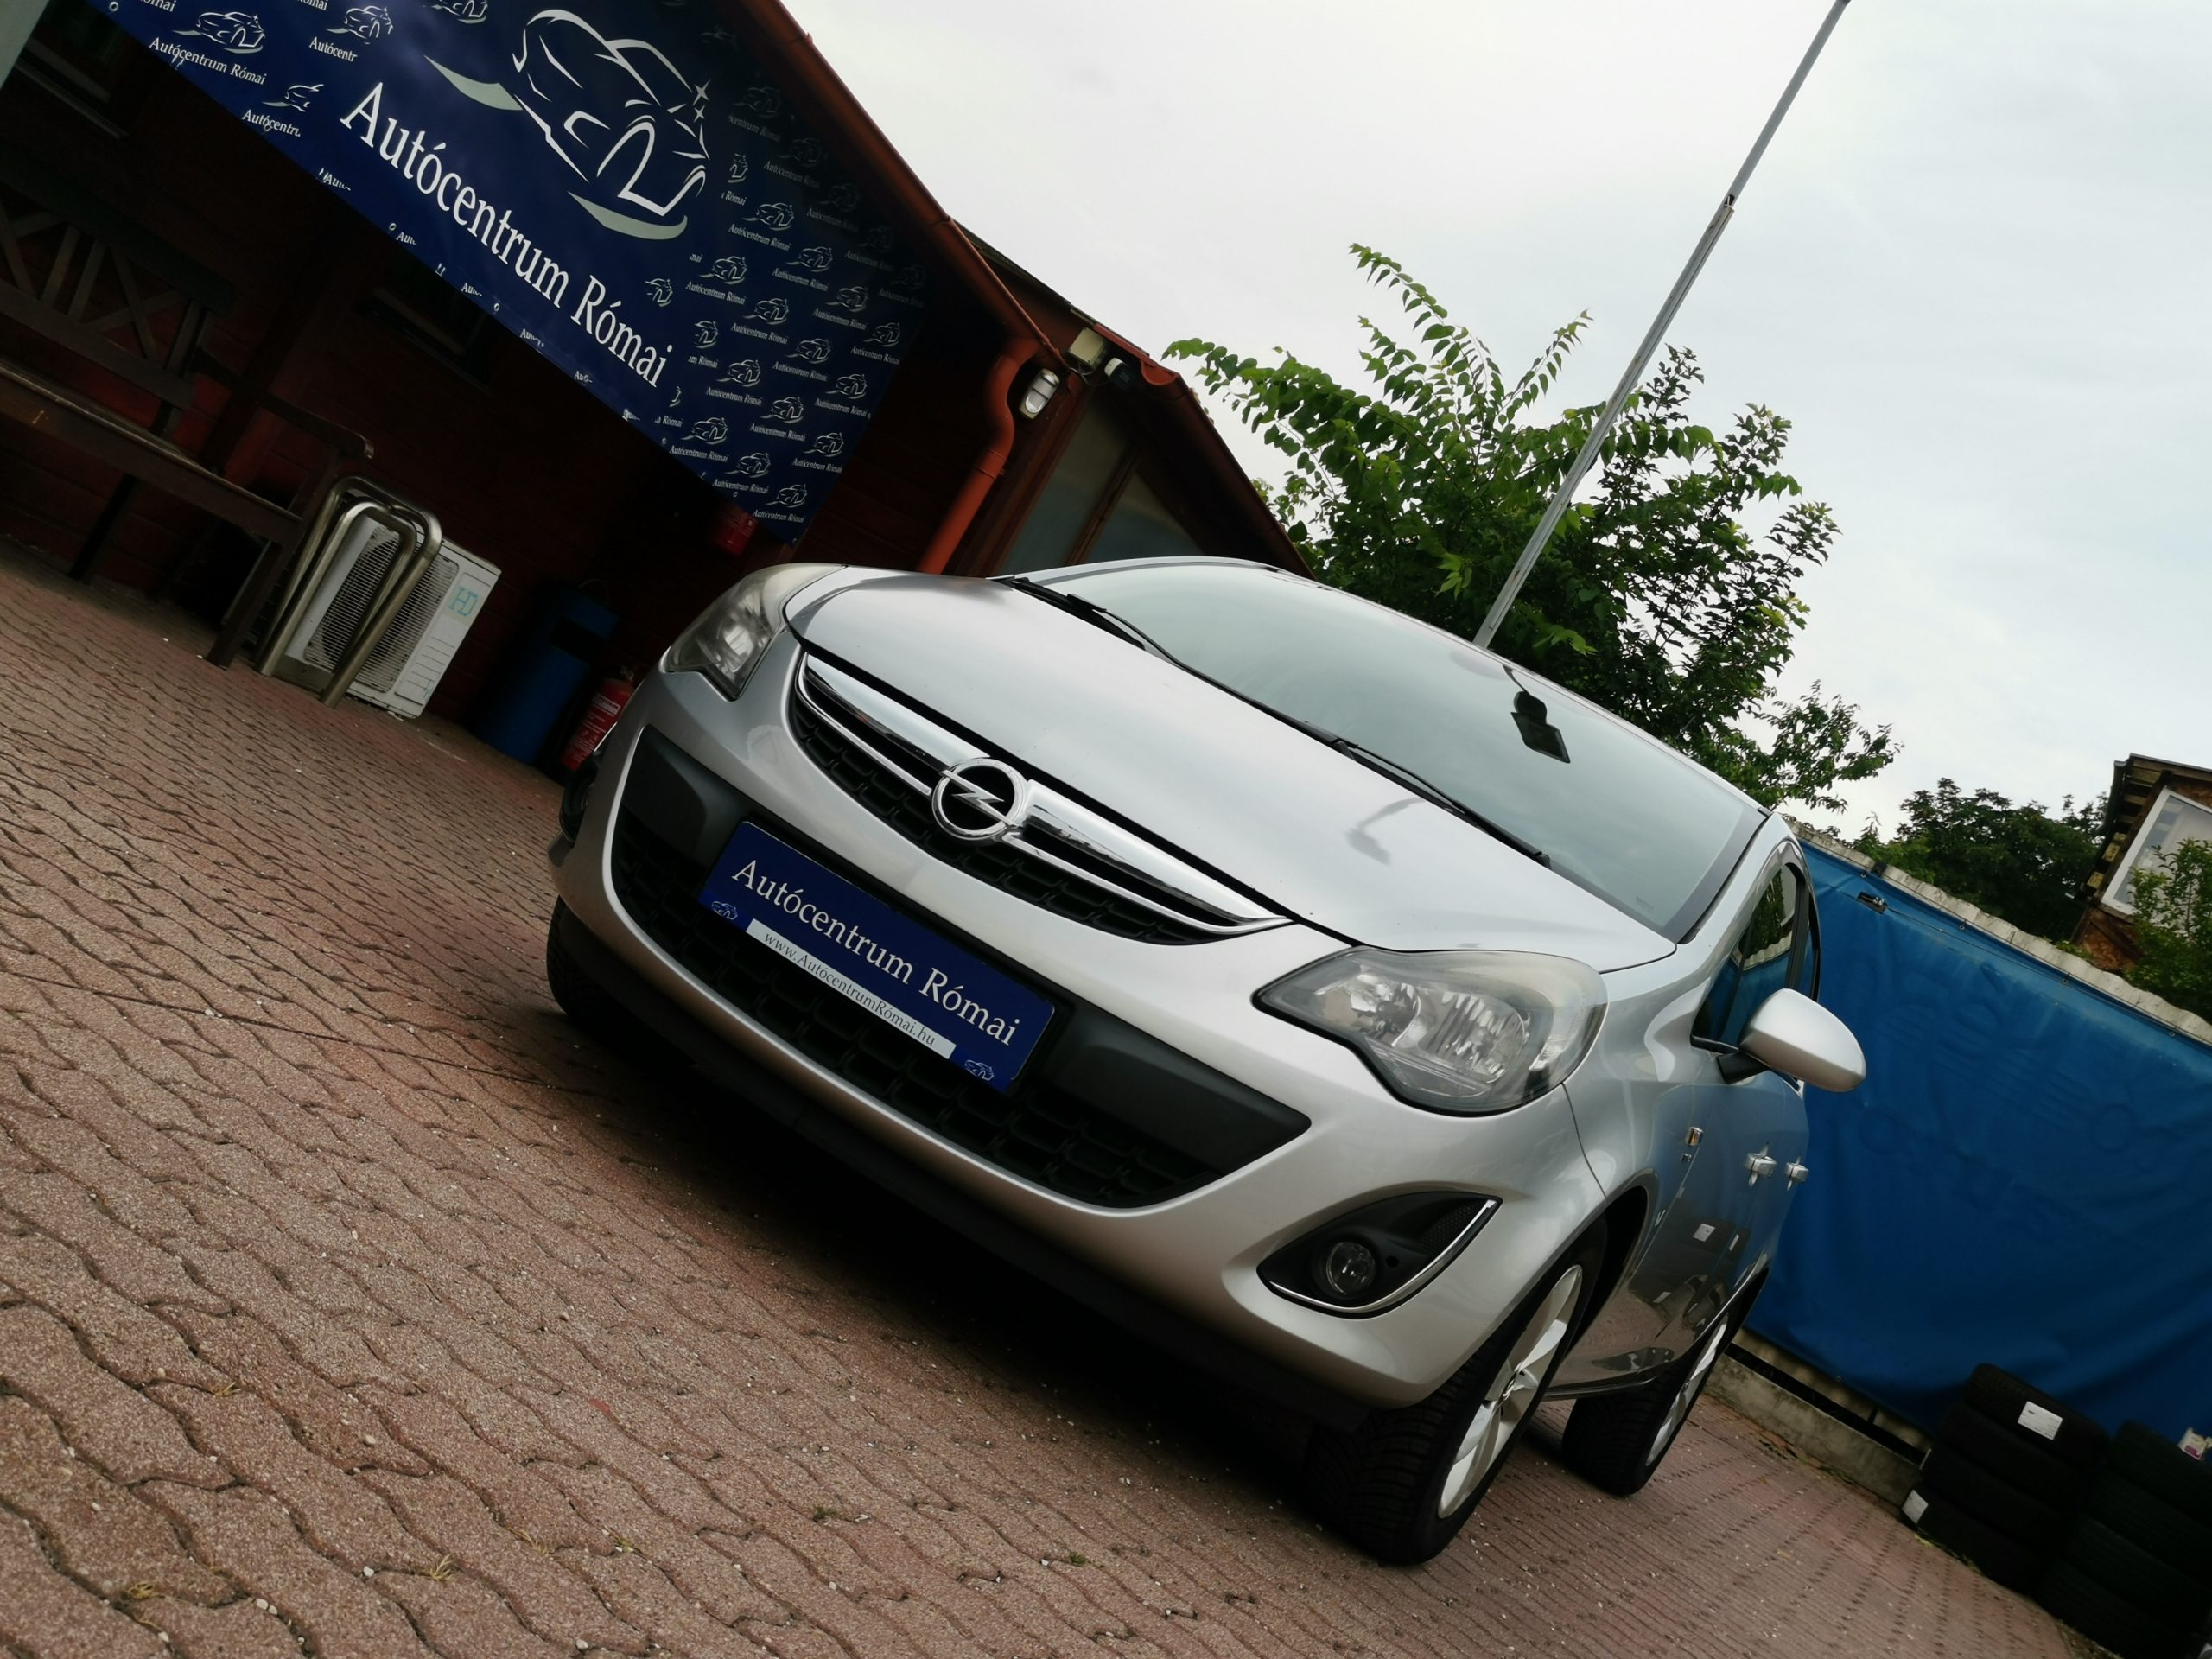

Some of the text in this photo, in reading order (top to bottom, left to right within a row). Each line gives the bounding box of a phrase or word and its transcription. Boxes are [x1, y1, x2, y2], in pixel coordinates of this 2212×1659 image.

[149, 37, 267, 85] Autócentrum Római
[340, 82, 673, 388] Autócentrum Római
[725, 190, 747, 206] Római
[731, 859, 1021, 1046] Autócentrum Római
[764, 933, 935, 1046] www.AutócentrumRómai.hu
